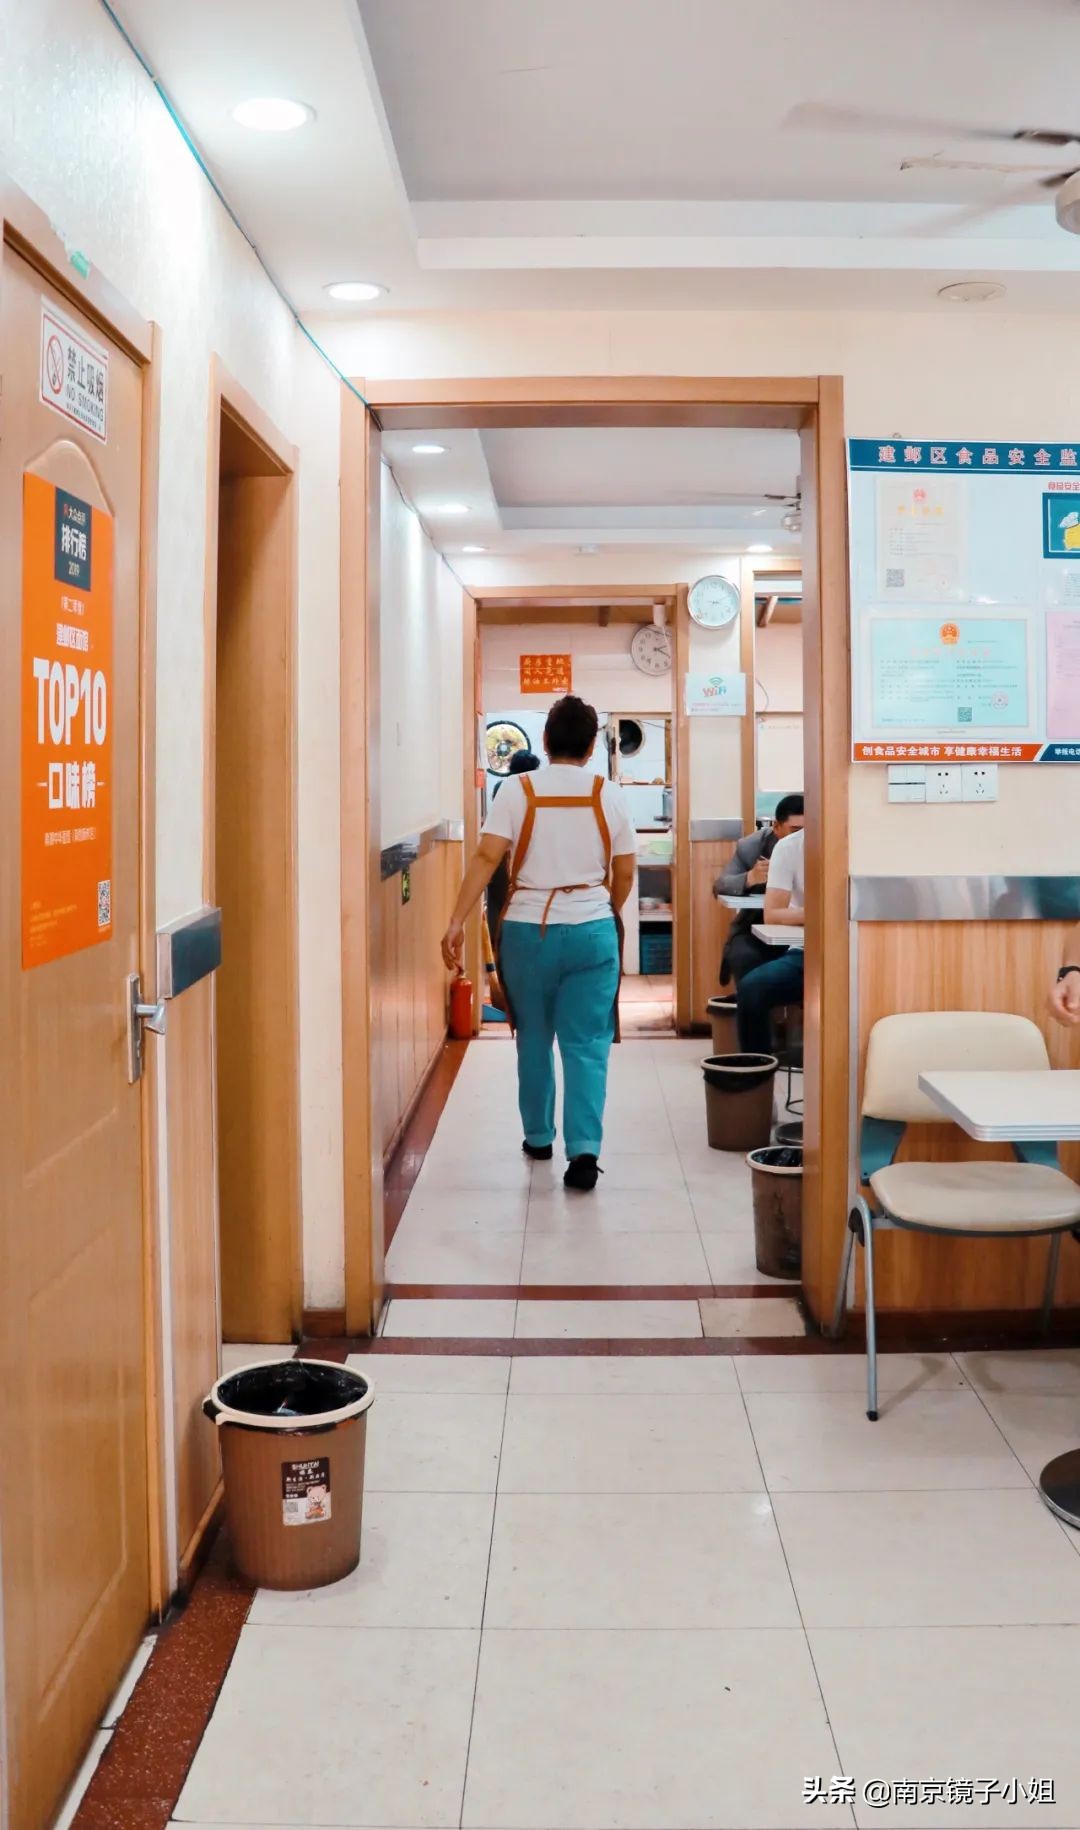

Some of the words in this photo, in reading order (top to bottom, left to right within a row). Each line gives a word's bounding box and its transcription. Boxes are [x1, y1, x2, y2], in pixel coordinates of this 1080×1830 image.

[66, 384, 76, 401] NO
[78, 392, 104, 422] SMOKING
[878, 445, 1078, 466] 建邺区食品安全监
[61, 524, 87, 561] 排行榜
[33, 656, 107, 745] TOP10
[862, 746, 941, 757] 创食品安全城市
[944, 746, 1022, 757] 享健康幸福生活
[48, 761, 96, 810] 口味榜
